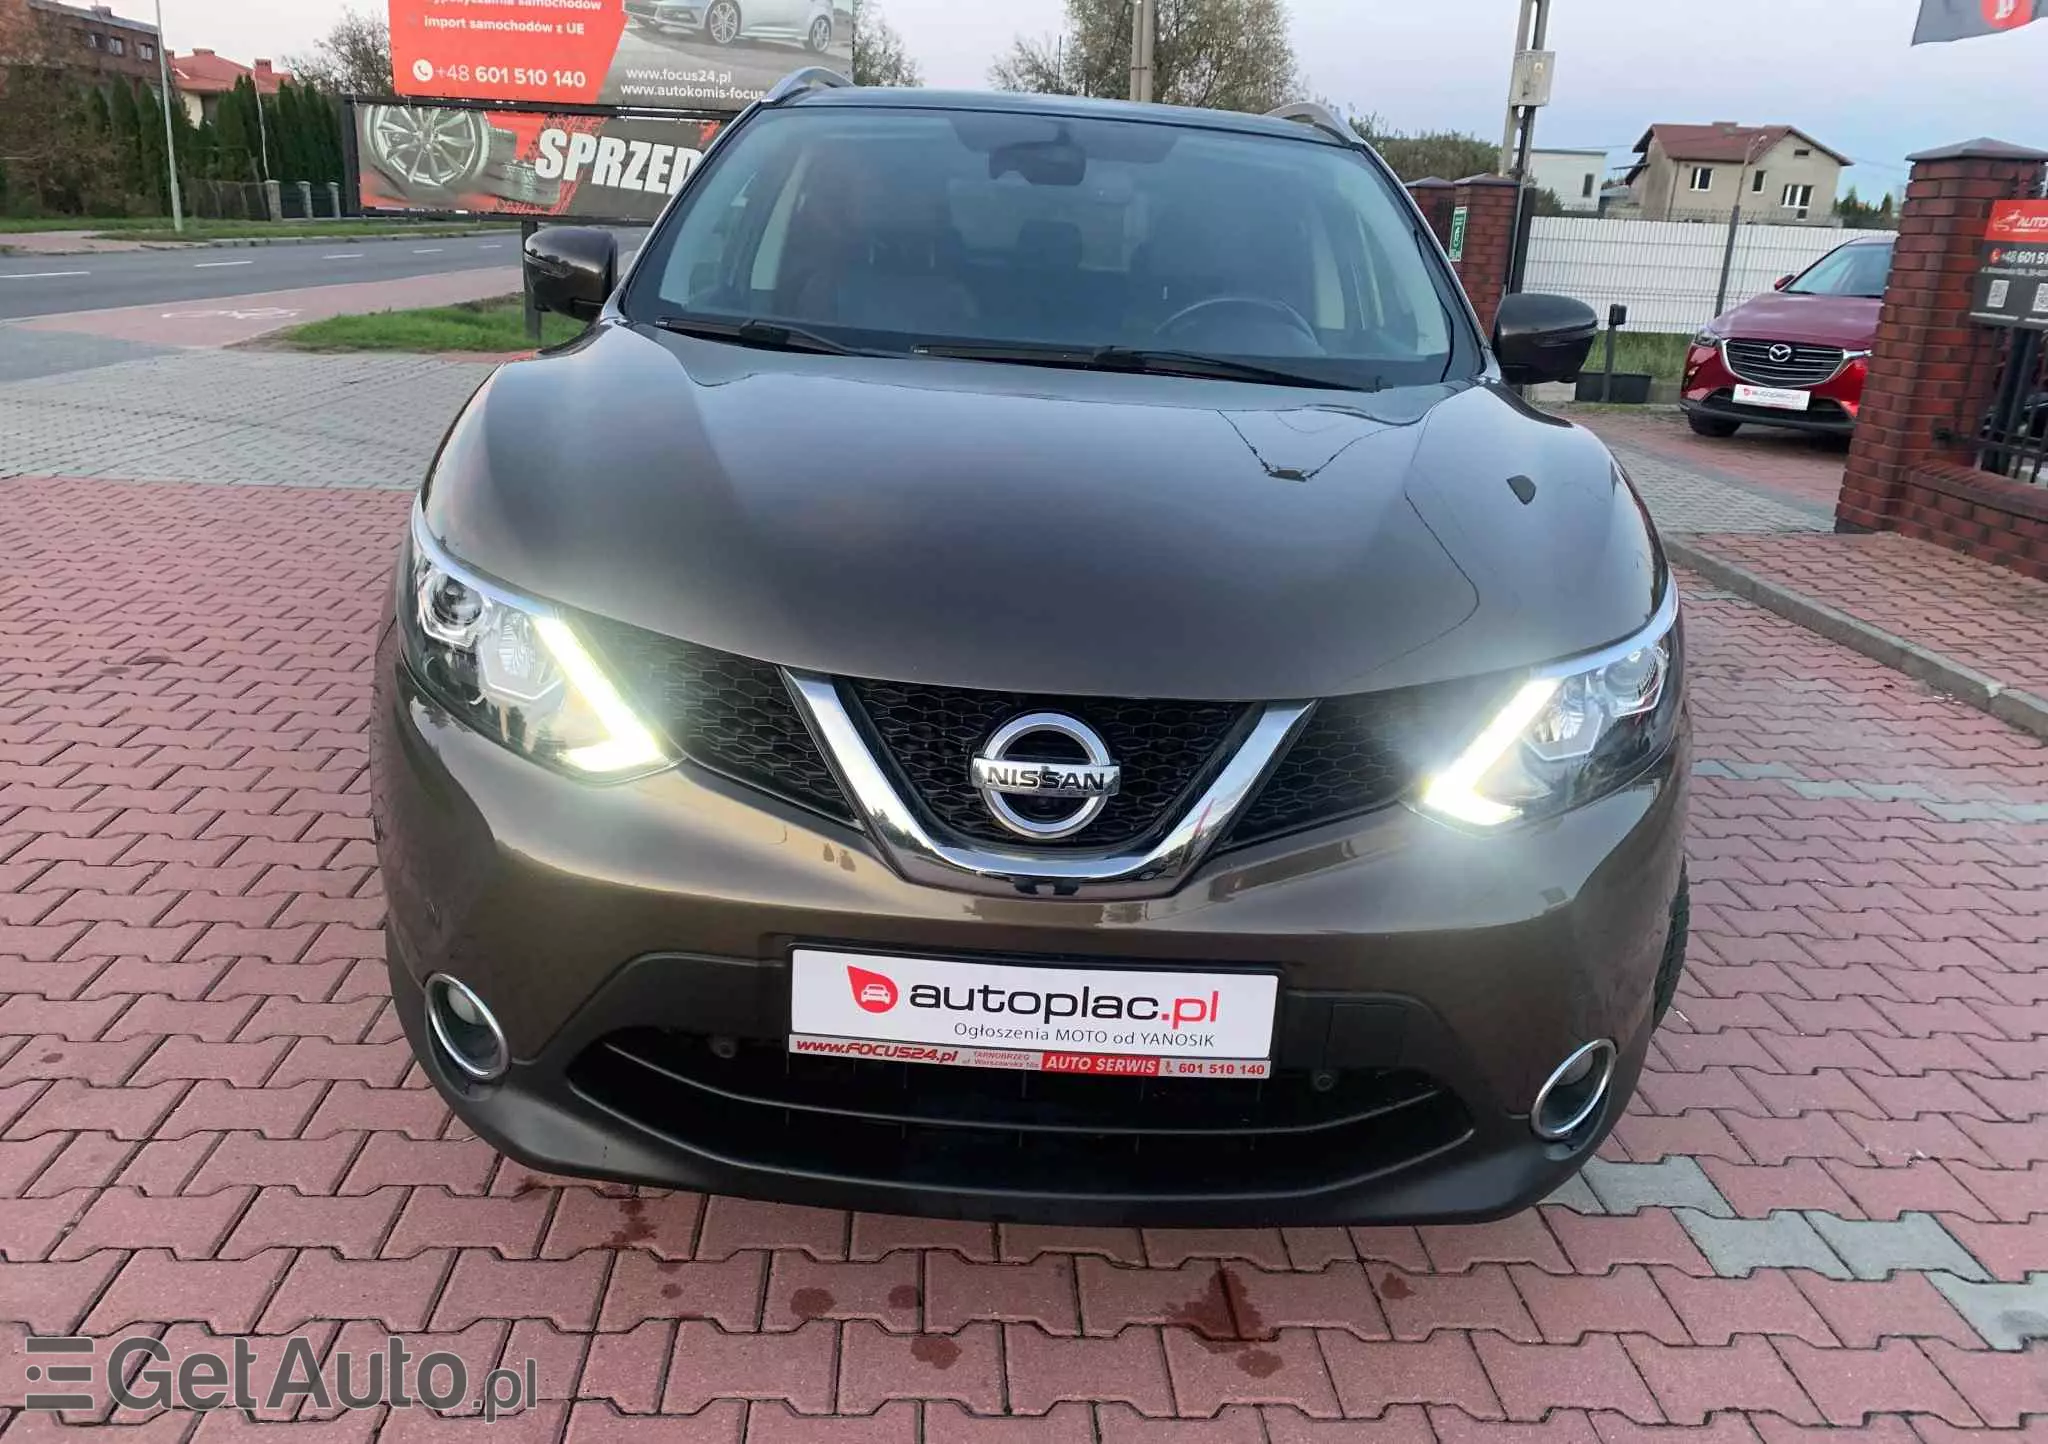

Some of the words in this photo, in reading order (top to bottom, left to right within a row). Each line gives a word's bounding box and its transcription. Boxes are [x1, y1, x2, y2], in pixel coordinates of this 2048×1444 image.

[425, 16, 465, 29] import
[470, 18, 552, 33] samochodów
[556, 25, 562, 33] z
[567, 23, 585, 34] UE
[435, 64, 469, 81] +48
[475, 66, 508, 83] 601
[514, 69, 547, 85] 510
[553, 70, 586, 87] 140
[626, 68, 731, 84] www.focus24.pl
[987, 767, 1105, 790] NISSAN
[909, 984, 1218, 1029] autoplac.pl
[954, 1023, 1049, 1041] Ogłoszenia
[1056, 1029, 1107, 1044] MOTO
[1113, 1032, 1134, 1045] od
[1140, 1033, 1215, 1047] YANOSIK
[1046, 1056, 1091, 1070] AUTO
[1096, 1059, 1156, 1073] SERWIS
[1179, 1063, 1203, 1073] 601
[1209, 1064, 1234, 1074] 510
[1240, 1064, 1264, 1075] 140
